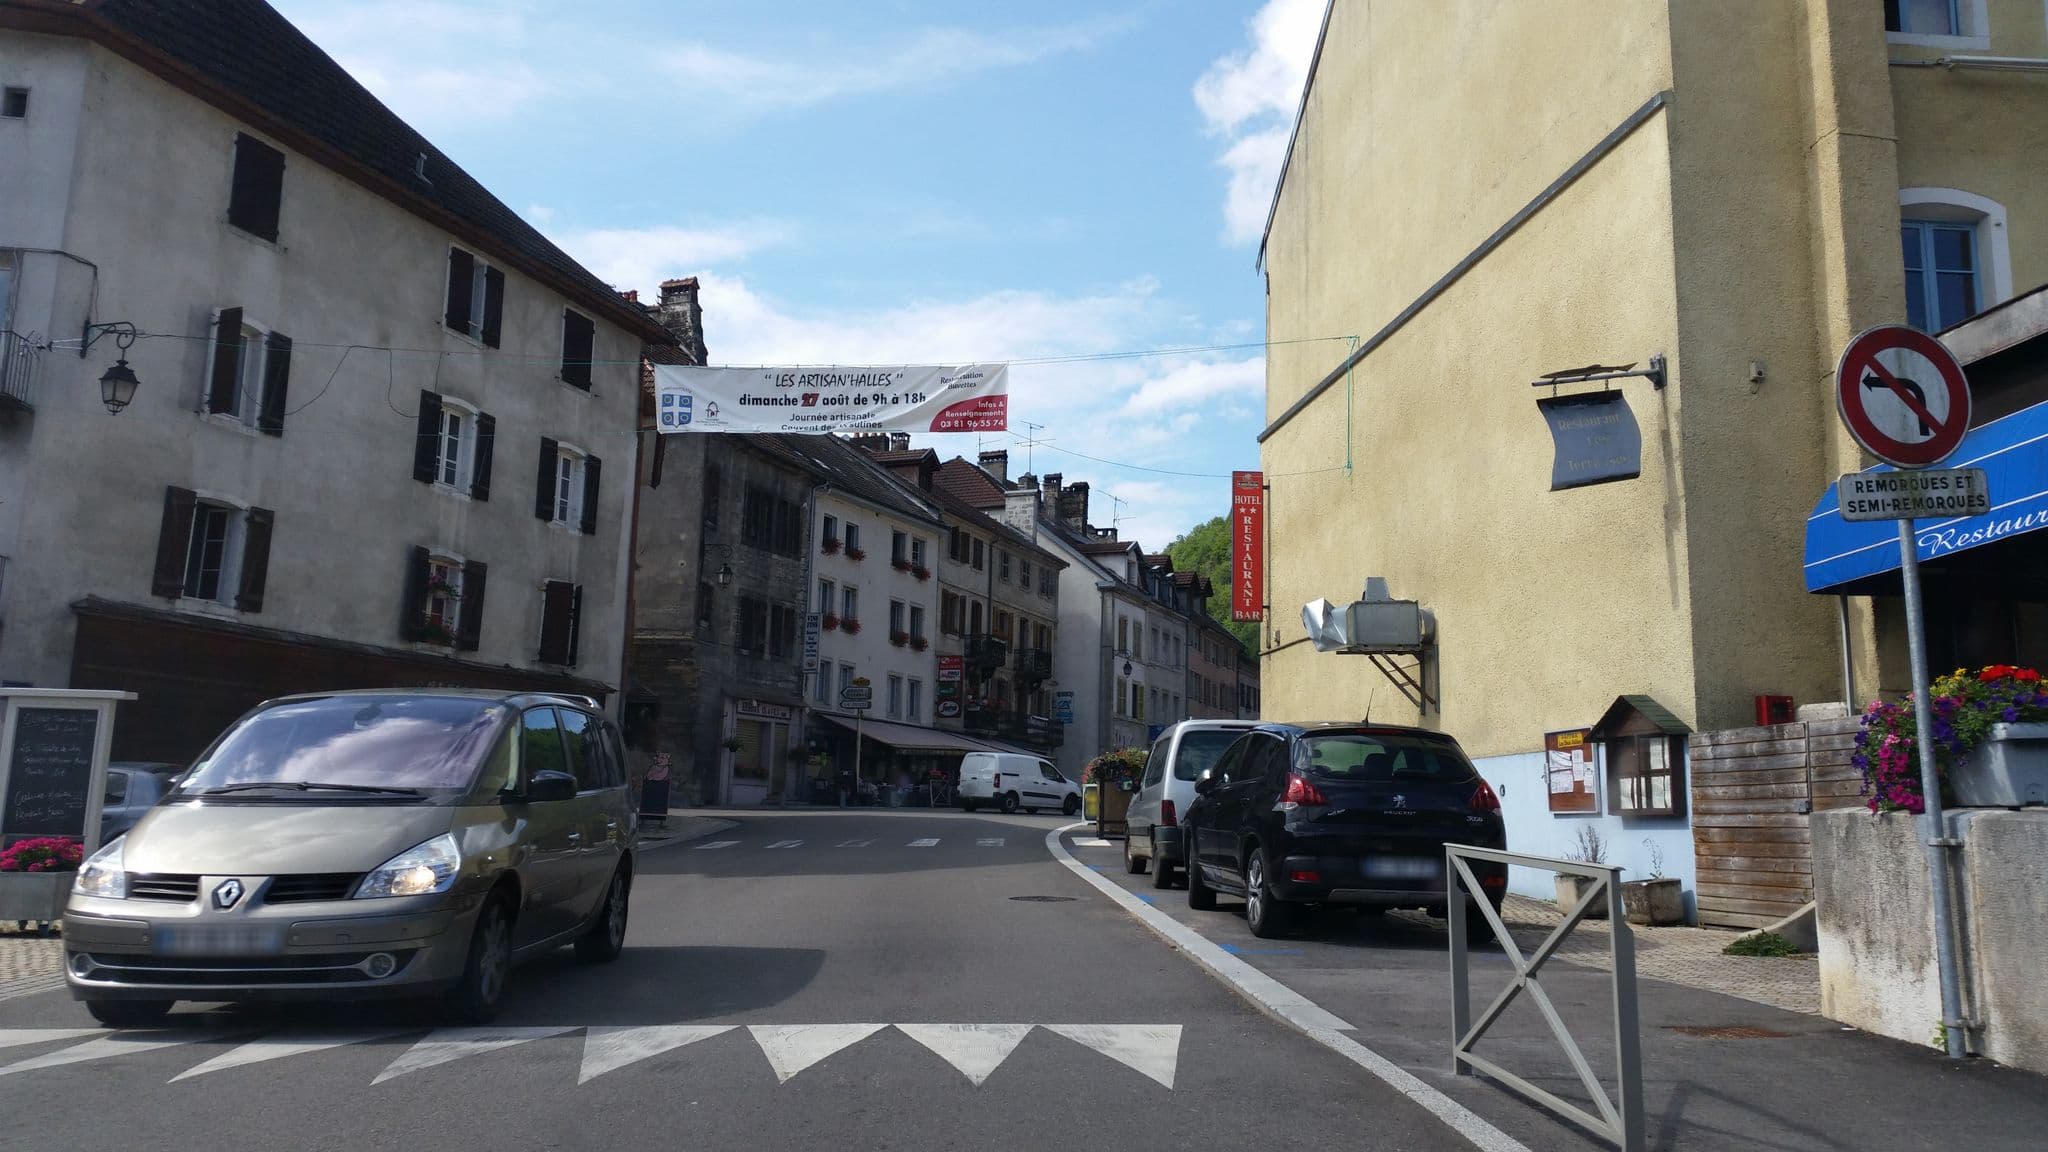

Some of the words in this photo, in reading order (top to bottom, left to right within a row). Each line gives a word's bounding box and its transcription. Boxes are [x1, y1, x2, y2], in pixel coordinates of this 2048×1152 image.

[775, 373, 796, 388] LES
[739, 393, 798, 407] dimanche
[801, 392, 820, 407] 27
[822, 393, 850, 406] août
[853, 393, 868, 406] de
[872, 393, 888, 405] 9h
[891, 393, 899, 405] à
[904, 391, 926, 405] 18h
[978, 400, 997, 408] Infos
[789, 412, 828, 422] Journée
[945, 408, 1004, 418] Renseignements
[940, 420, 952, 428] 03
[954, 420, 964, 428] 81
[993, 419, 1004, 427] 74
[1855, 477, 1950, 493] REMORQUES
[1956, 476, 1974, 489] ET
[1234, 495, 1262, 505] HOTEL
[1847, 494, 1986, 513] SEMI-REMORQUES
[1242, 515, 1253, 607] RESTAURANT
[1235, 610, 1261, 620] BAR
